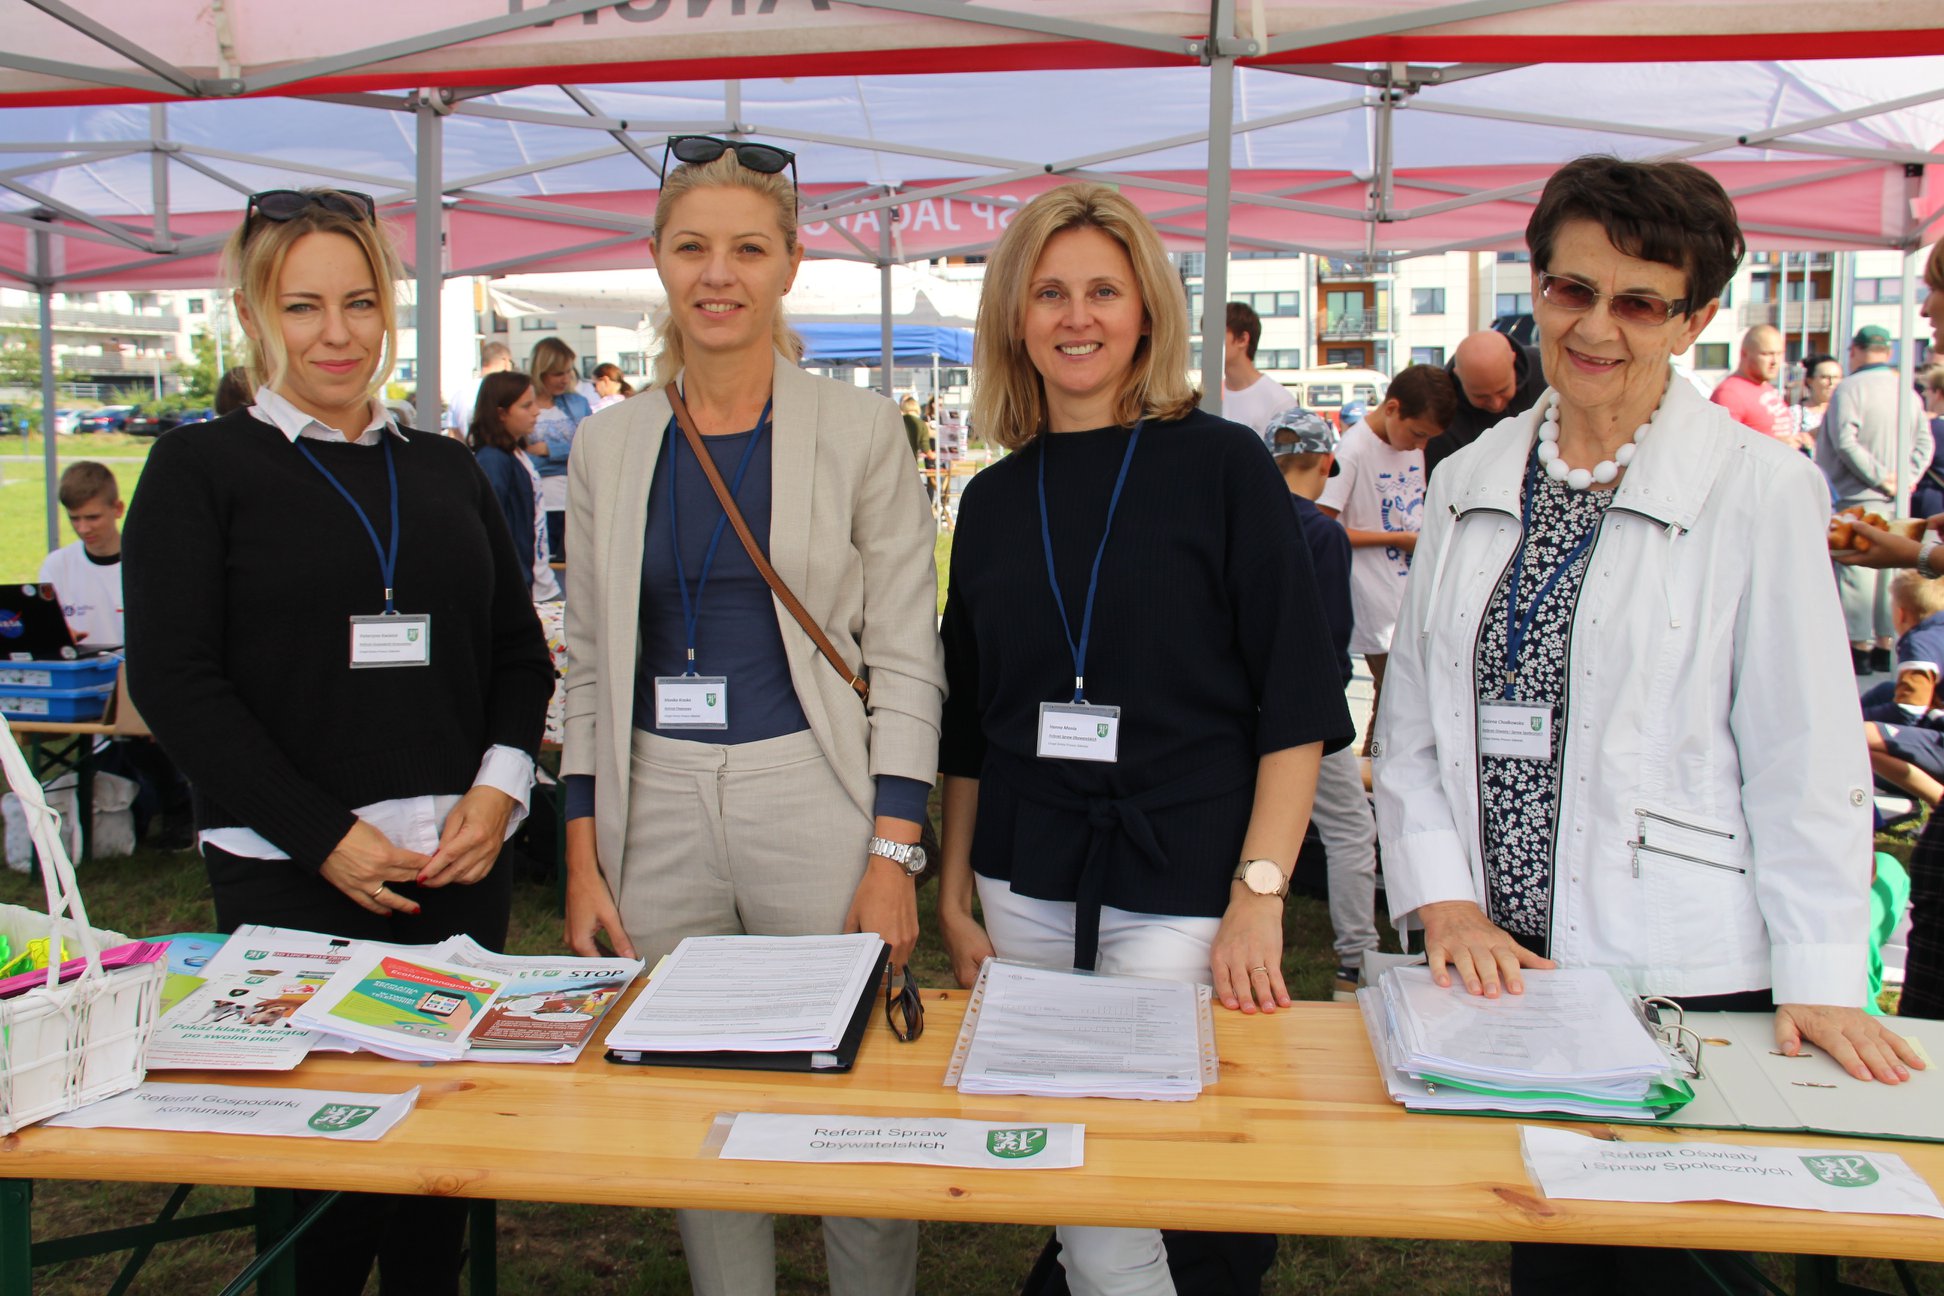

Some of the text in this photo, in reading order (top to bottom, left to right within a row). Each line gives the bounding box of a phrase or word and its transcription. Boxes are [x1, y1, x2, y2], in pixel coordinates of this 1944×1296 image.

[567, 969, 625, 978] STOP
[172, 1023, 311, 1037] Pokaż klasę, sprzątaj
[203, 1033, 248, 1041] swoim
[135, 1092, 303, 1109] Referat Gospodarki
[155, 1105, 261, 1119] Komunalnej
[813, 1128, 948, 1139] Referat Spraw
[809, 1140, 946, 1151] Obywatelskich
[1600, 1148, 1759, 1162] Referat Oświaty
[1582, 1161, 1794, 1177] i Spraw Społecznych
